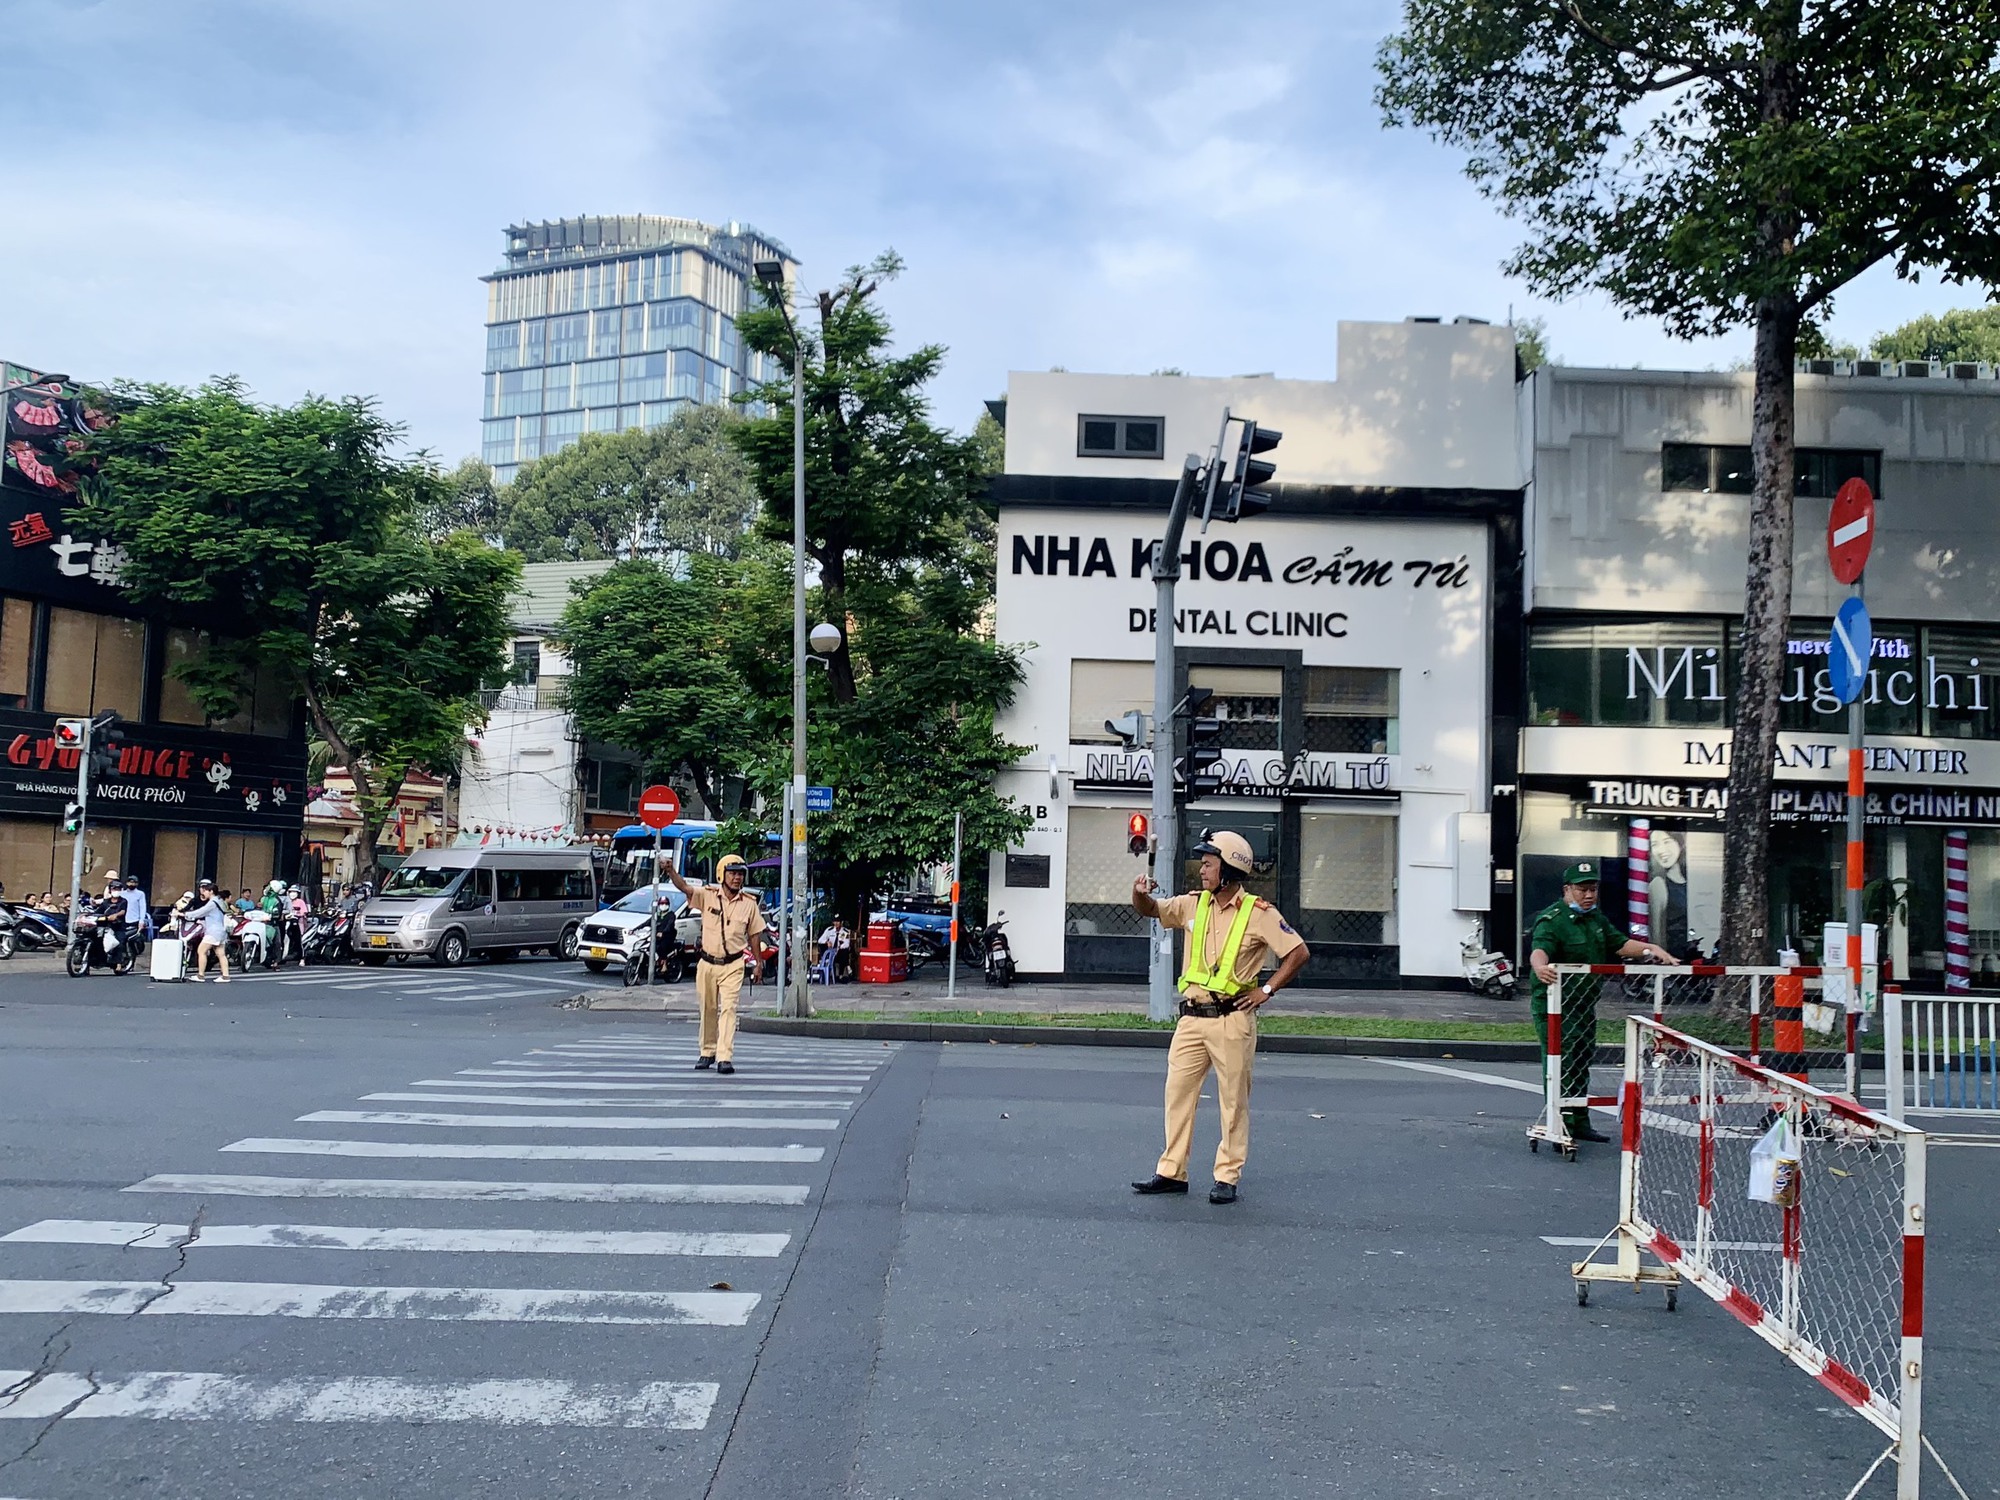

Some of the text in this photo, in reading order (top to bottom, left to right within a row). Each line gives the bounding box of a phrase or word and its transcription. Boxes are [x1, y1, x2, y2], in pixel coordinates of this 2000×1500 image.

[1012, 535, 1116, 578] NHA
[1282, 546, 1394, 587] CẨM
[1403, 555, 1470, 588] TÚ
[1246, 610, 1348, 638] CLINIC
[1086, 753, 1154, 781] NHA
[1263, 749, 1336, 787] CẨM
[1346, 757, 1390, 790] TÚ
[1242, 786, 1290, 796] CLINIC
[1588, 780, 1680, 807] TRUNG
[1866, 792, 1883, 814] &
[1862, 815, 1901, 825] ENTER
